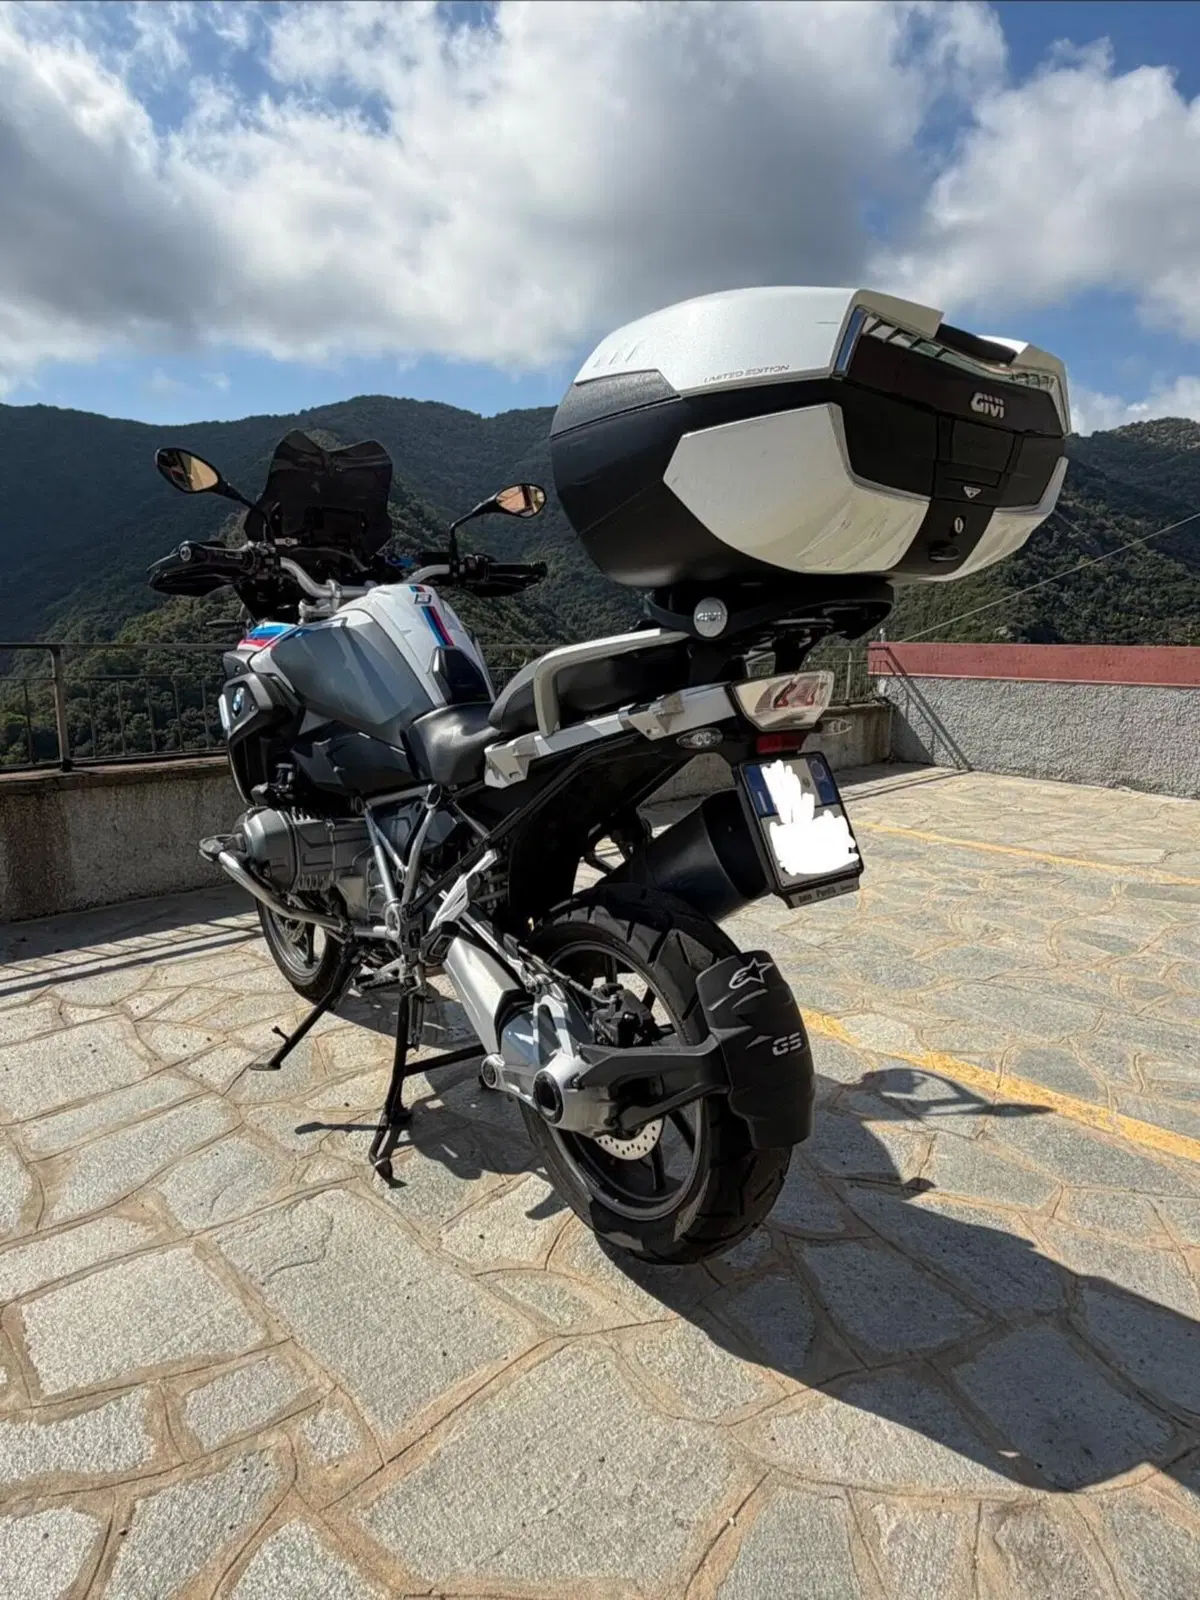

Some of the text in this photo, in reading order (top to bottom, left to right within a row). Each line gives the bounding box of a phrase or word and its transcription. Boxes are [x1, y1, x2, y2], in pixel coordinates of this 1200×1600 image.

[704, 364, 790, 383] LIMITED EDITION
[771, 1032, 803, 1056] GS
